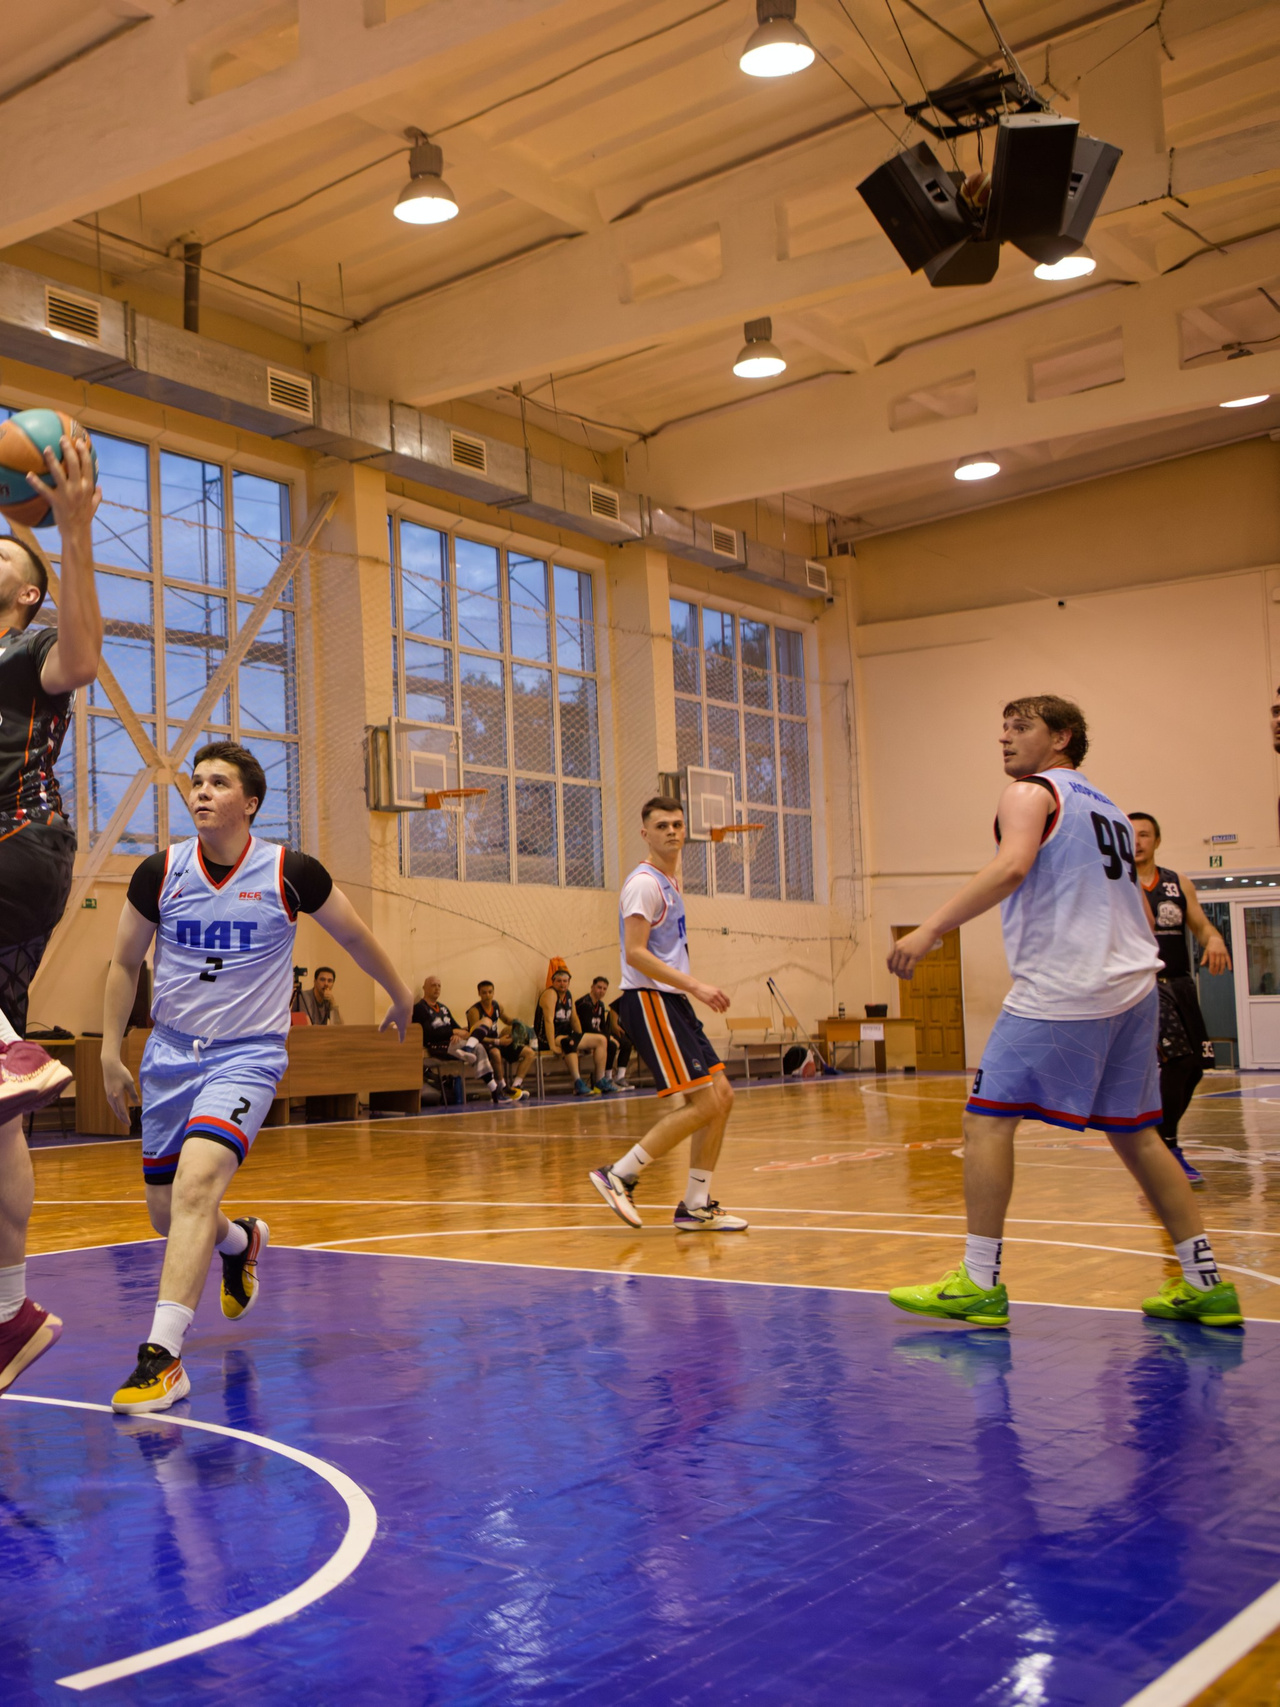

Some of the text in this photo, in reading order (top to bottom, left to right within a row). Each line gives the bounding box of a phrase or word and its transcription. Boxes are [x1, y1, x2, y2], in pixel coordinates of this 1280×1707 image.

[1090, 810, 1138, 886] 99
[1162, 881, 1180, 897] 33
[176, 920, 258, 951] ПАТ
[199, 956, 224, 983] 2
[230, 1097, 251, 1126] 2
